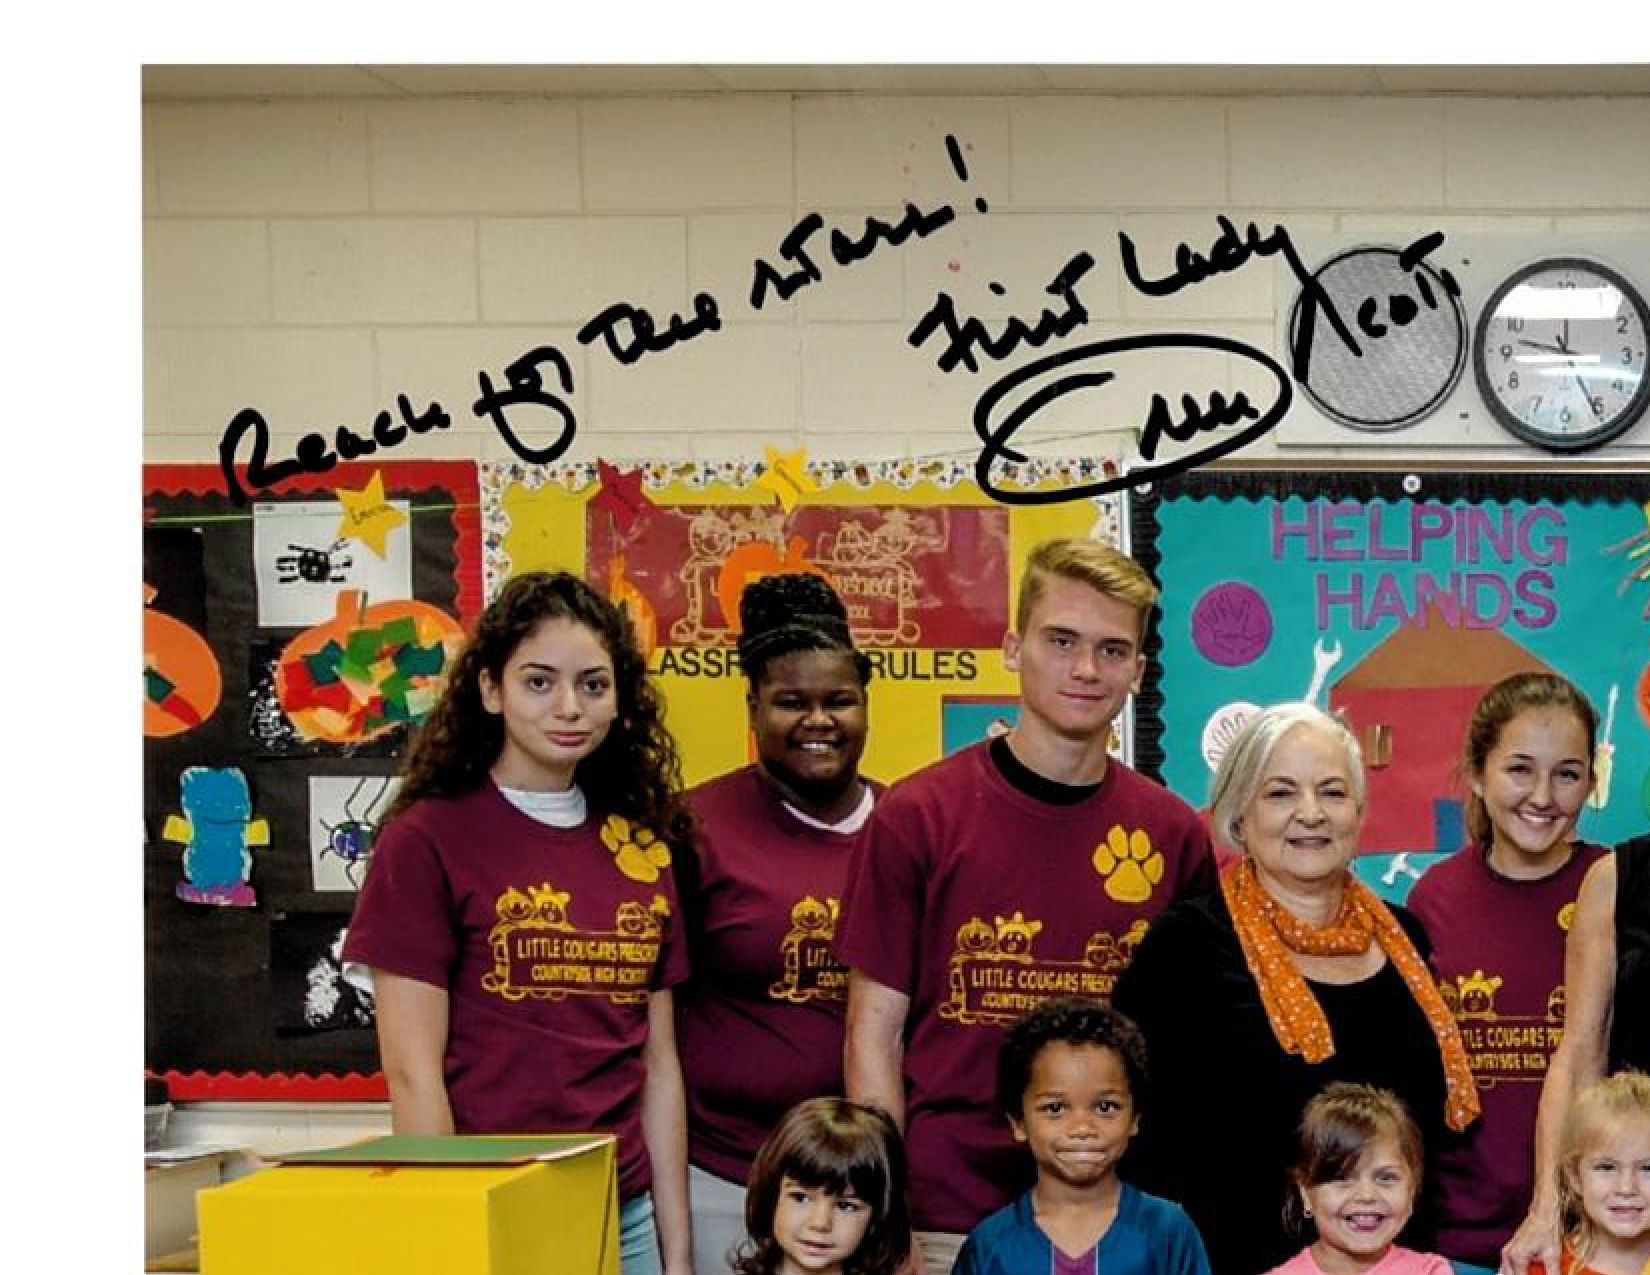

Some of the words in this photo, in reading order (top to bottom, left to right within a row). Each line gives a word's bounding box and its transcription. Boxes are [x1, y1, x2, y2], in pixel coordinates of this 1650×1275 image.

[1617, 315, 1628, 334] 2
[1500, 344, 1512, 362] 9
[1621, 345, 1632, 365] 3
[1271, 500, 1569, 566] HELPING
[1315, 569, 1559, 631] HANDS
[869, 650, 978, 681] RULES
[517, 938, 561, 959] LITTLE
[971, 967, 1014, 989] LITTLE
[1017, 969, 1079, 993] COUGARS
[1486, 1026, 1545, 1047] COUGARS
